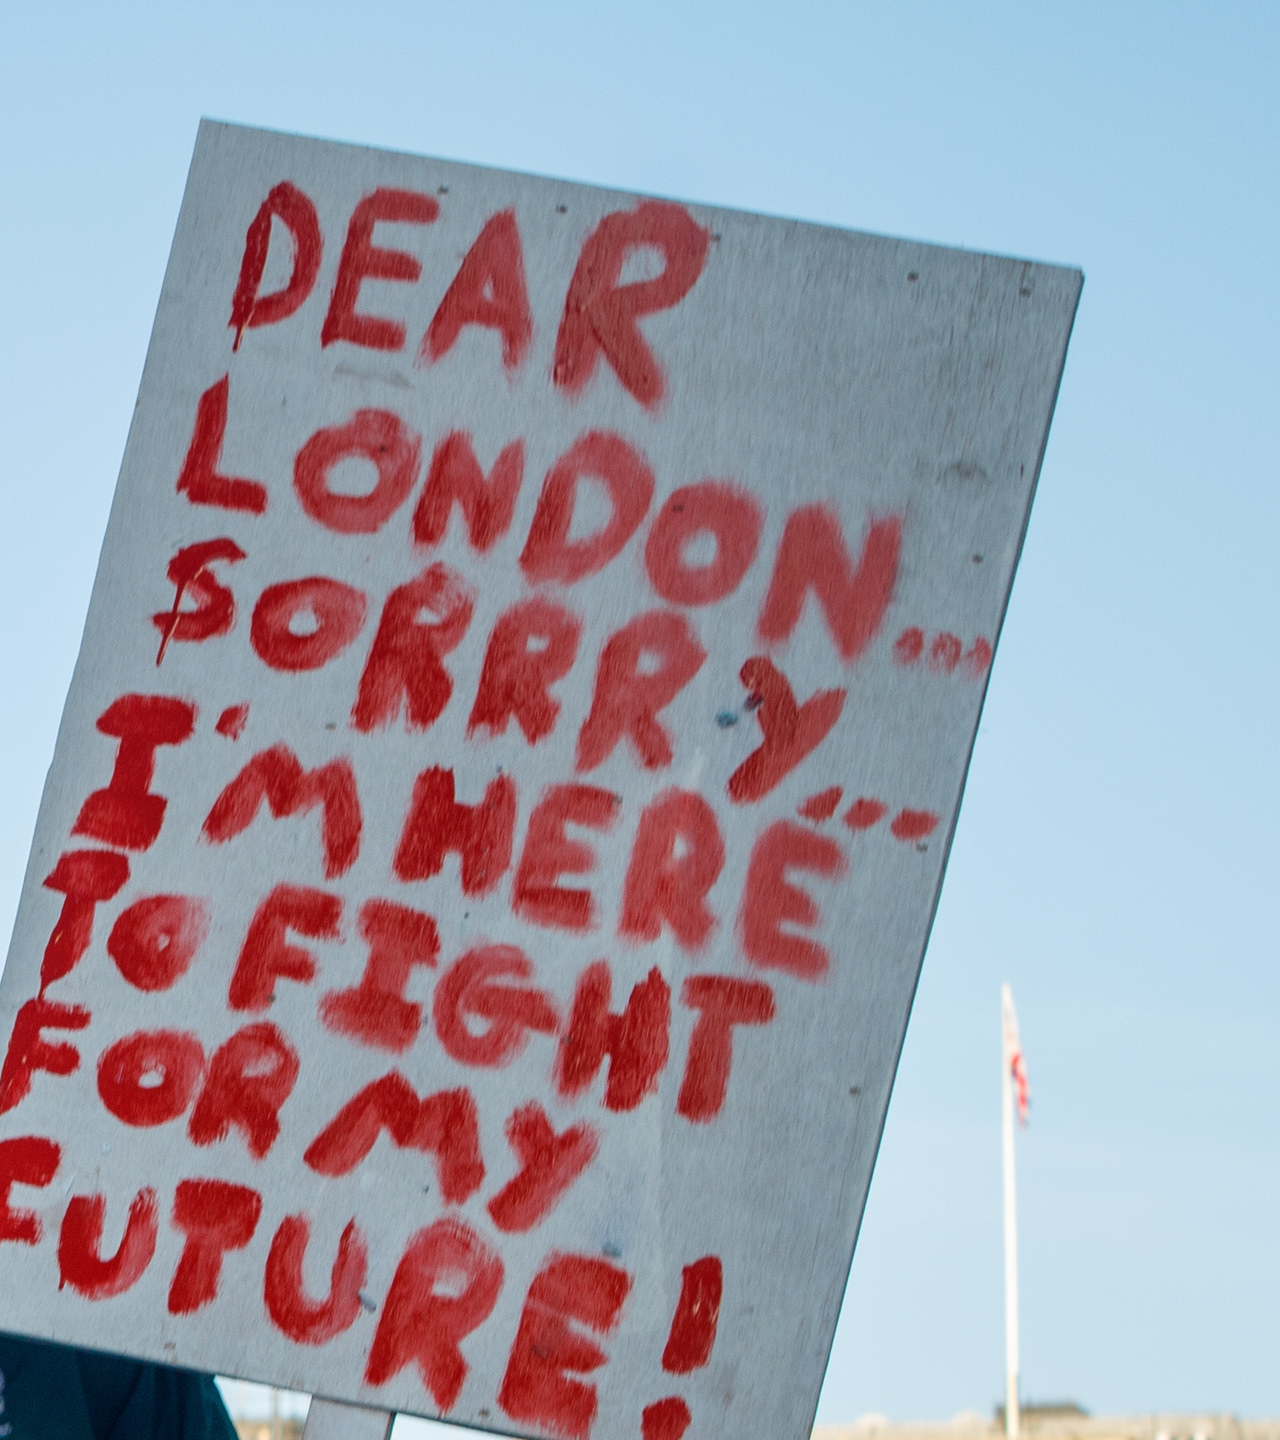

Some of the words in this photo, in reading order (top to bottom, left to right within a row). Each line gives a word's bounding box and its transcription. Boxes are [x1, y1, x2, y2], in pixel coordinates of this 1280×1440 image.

[226, 180, 710, 412] DEAR
[71, 691, 364, 882] I'M
[391, 765, 844, 982] HERE
[38, 848, 211, 998] TO
[228, 882, 776, 1126] FIGHT
[303, 1070, 600, 1235] MY
